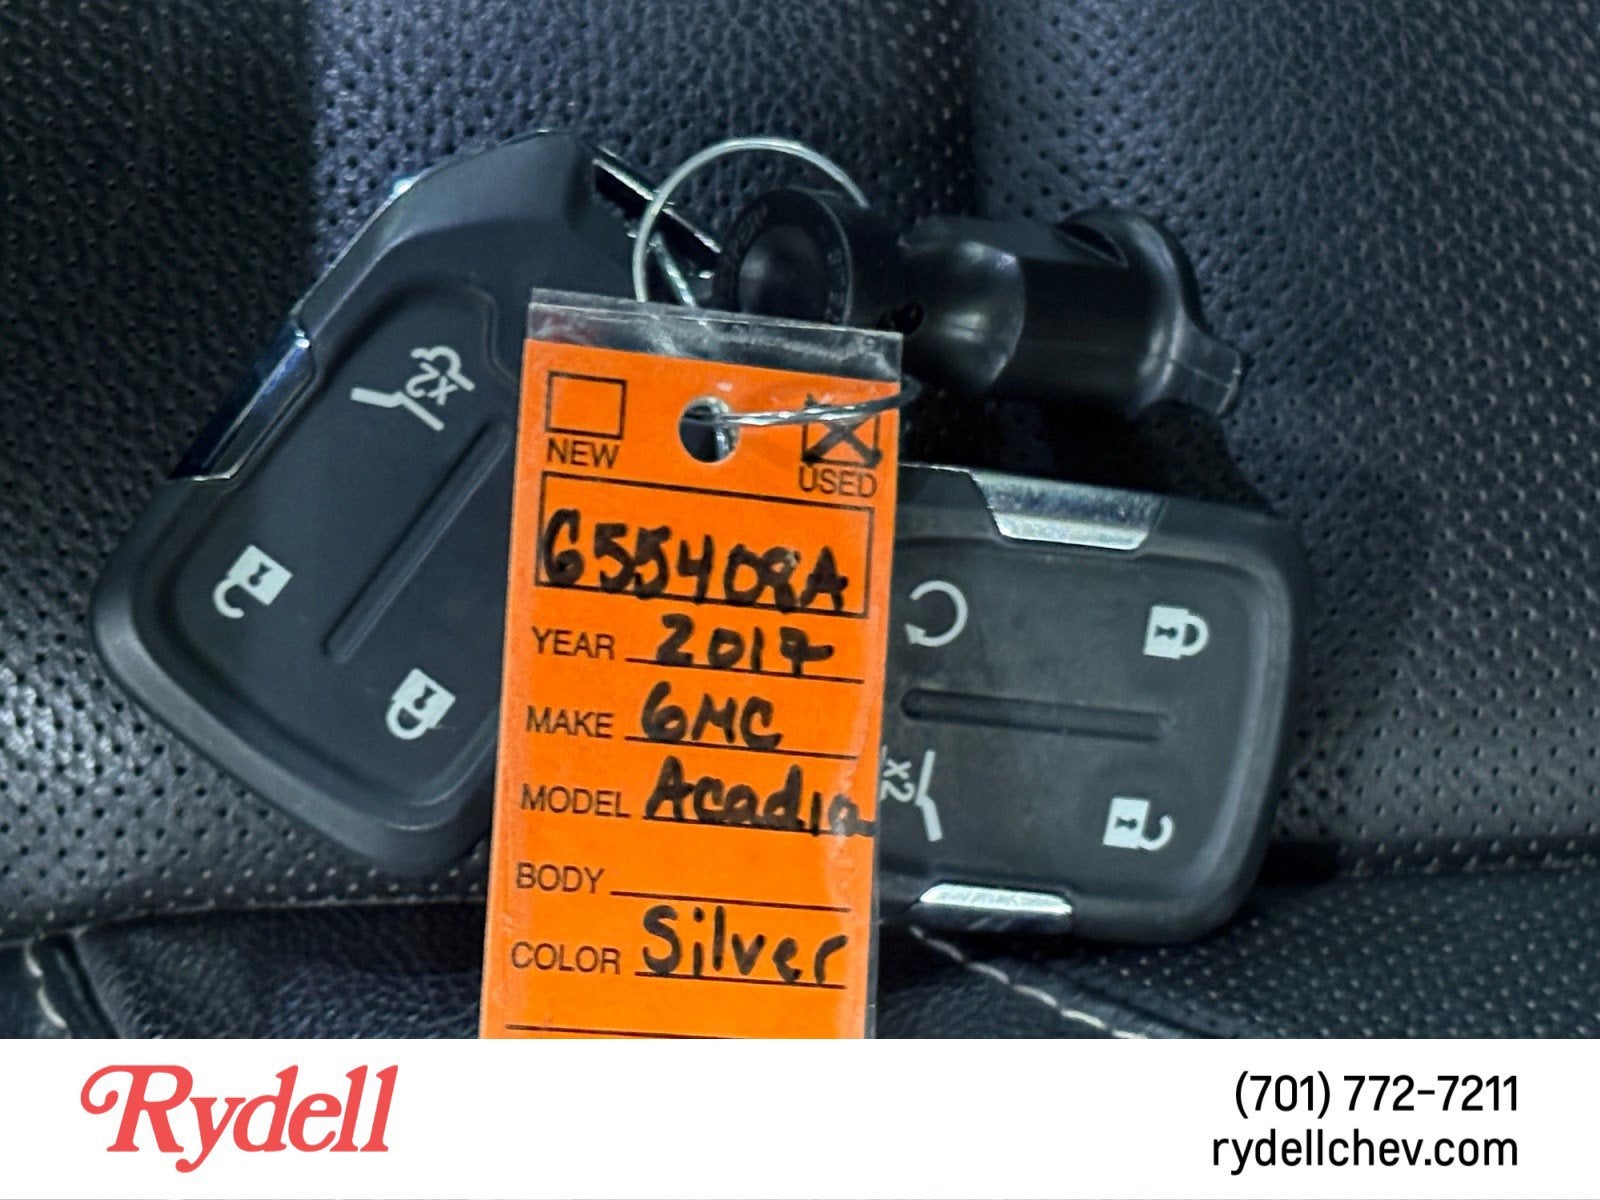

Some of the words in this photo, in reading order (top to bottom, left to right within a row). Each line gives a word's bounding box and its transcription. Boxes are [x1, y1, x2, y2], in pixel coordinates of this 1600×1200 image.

[547, 439, 621, 470] NEW
[798, 467, 878, 499] USED
[531, 627, 616, 661] YEAR
[655, 613, 834, 676] 2017
[525, 705, 615, 739] MAKE
[520, 784, 632, 819] MODEL
[643, 756, 875, 837] Acadia
[515, 862, 606, 894] BODY
[510, 941, 622, 975] COLOR
[641, 904, 849, 985] Silver
